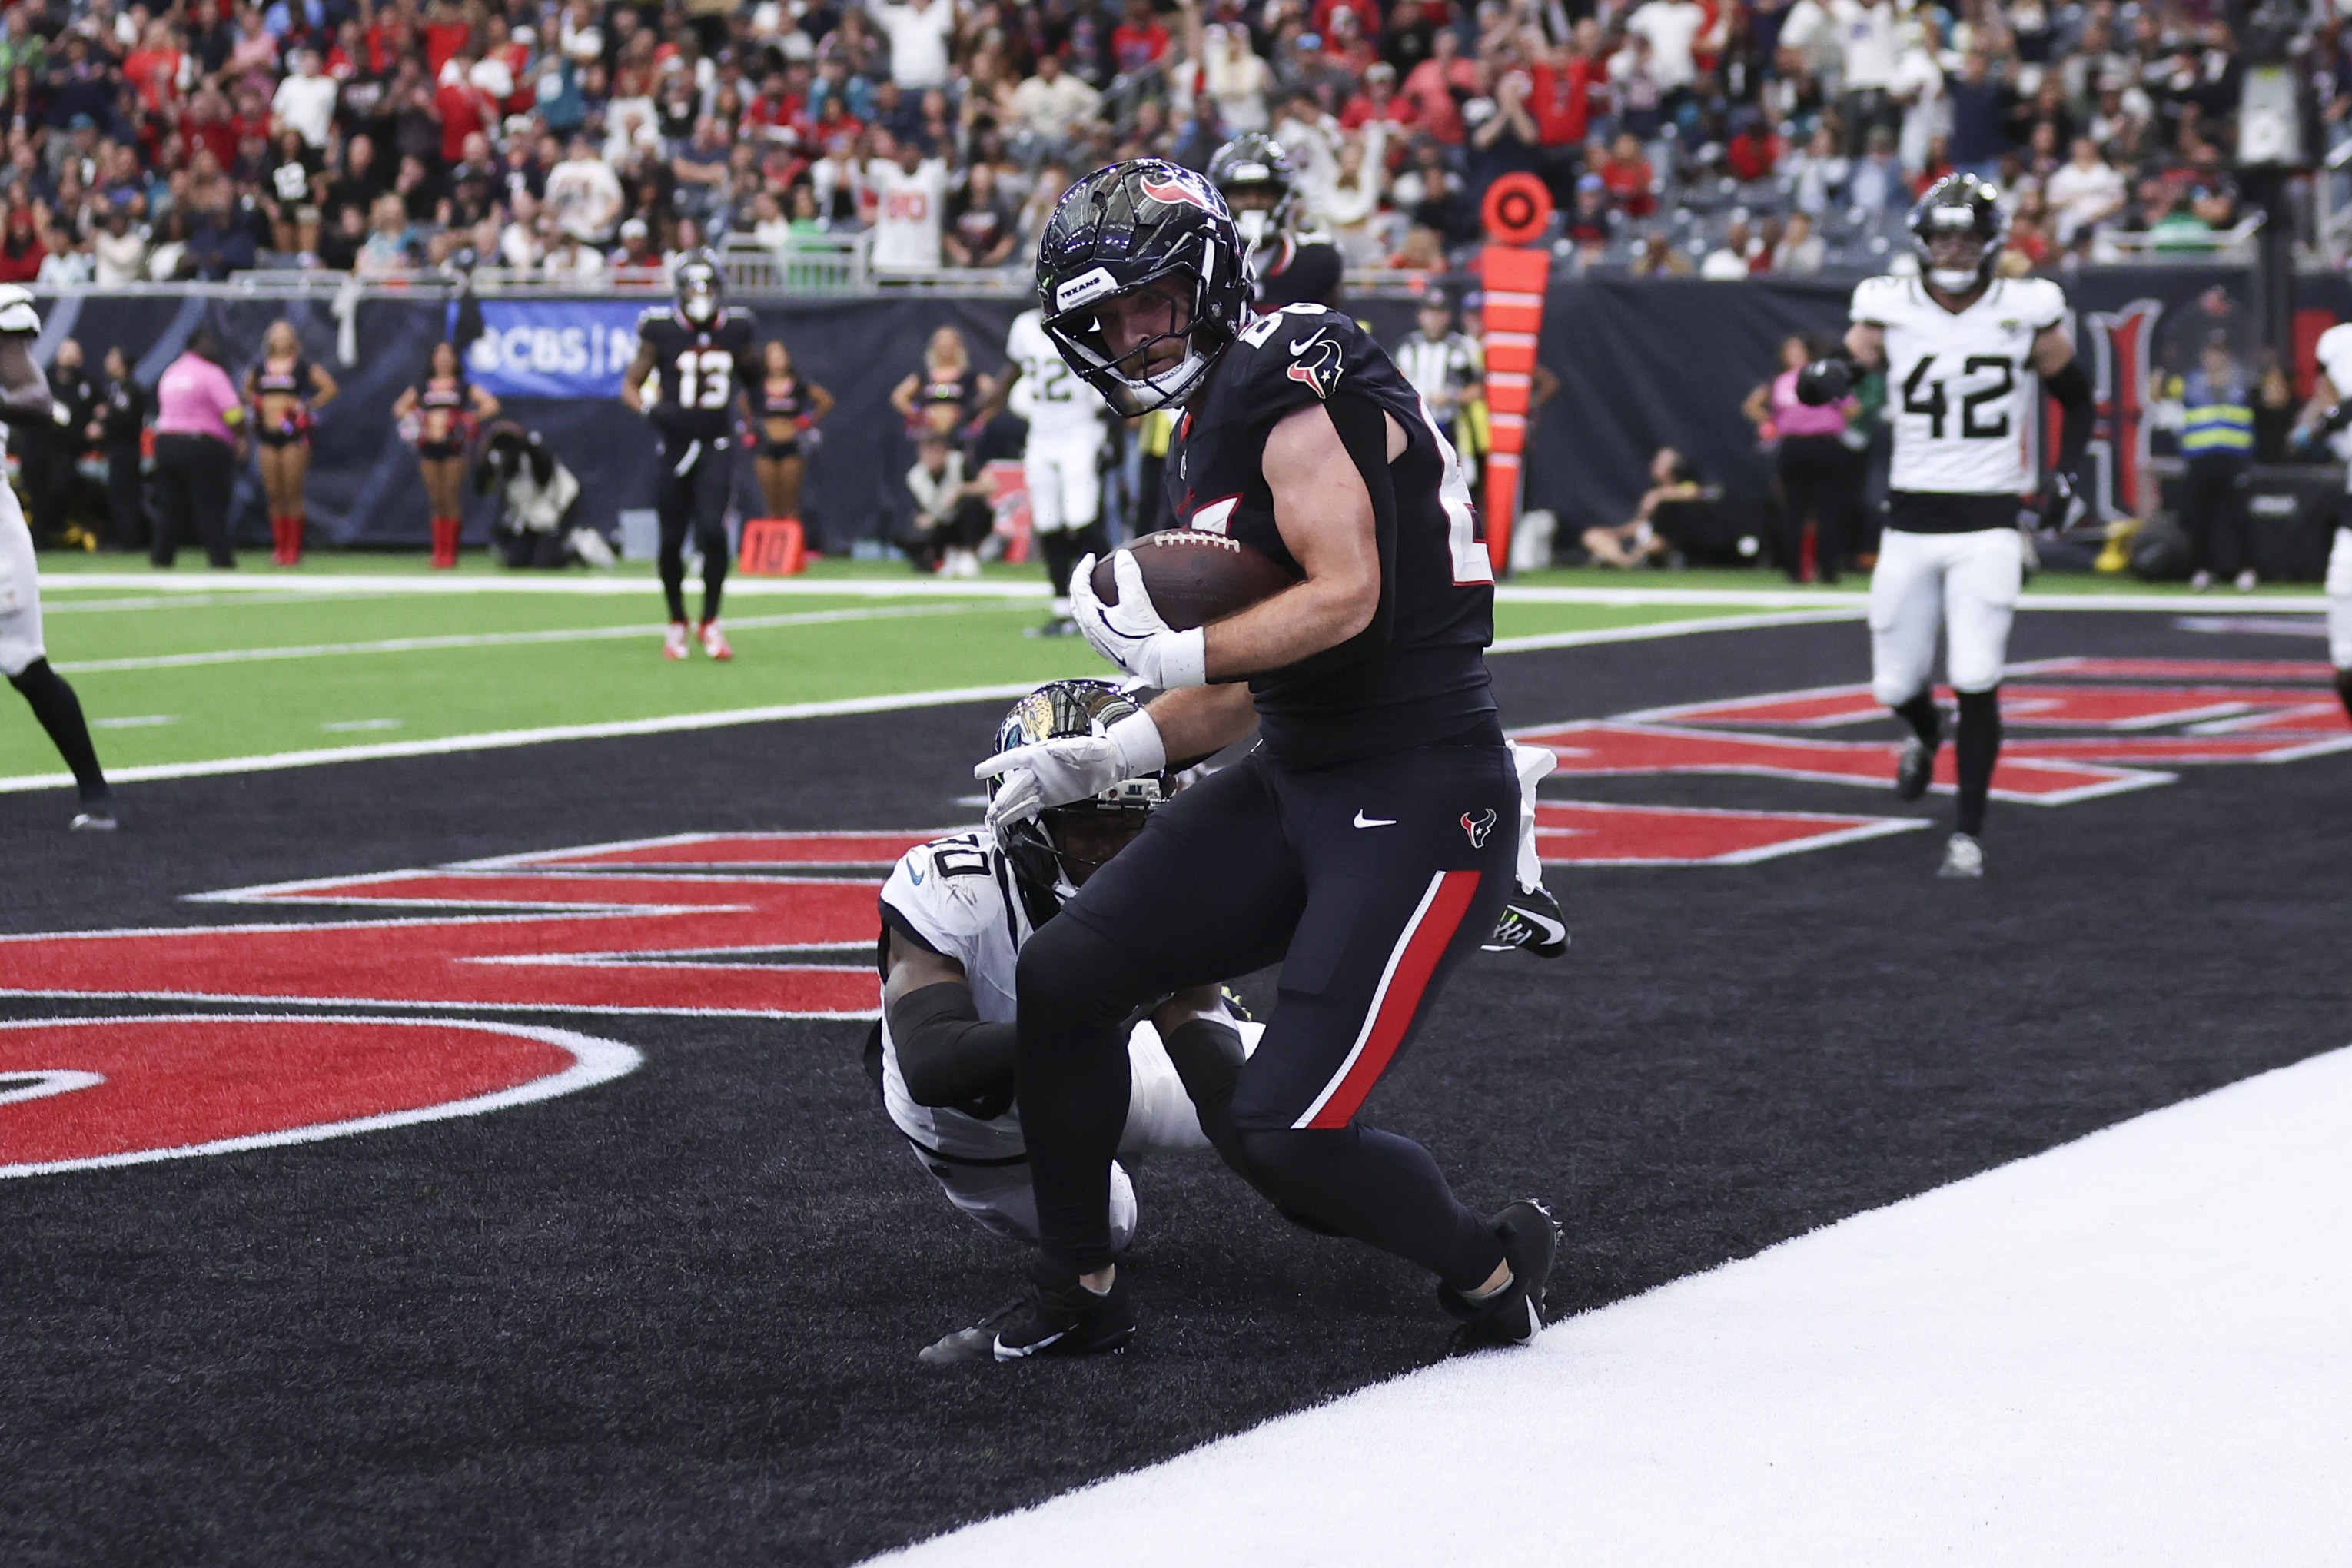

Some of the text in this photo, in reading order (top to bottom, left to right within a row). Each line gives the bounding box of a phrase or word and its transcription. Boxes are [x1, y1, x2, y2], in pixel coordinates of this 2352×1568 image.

[1060, 277, 1101, 298] TEXANS
[499, 326, 590, 374] CBS
[675, 350, 734, 408] 13
[1904, 355, 2013, 439] 42
[752, 530, 787, 571] 10
